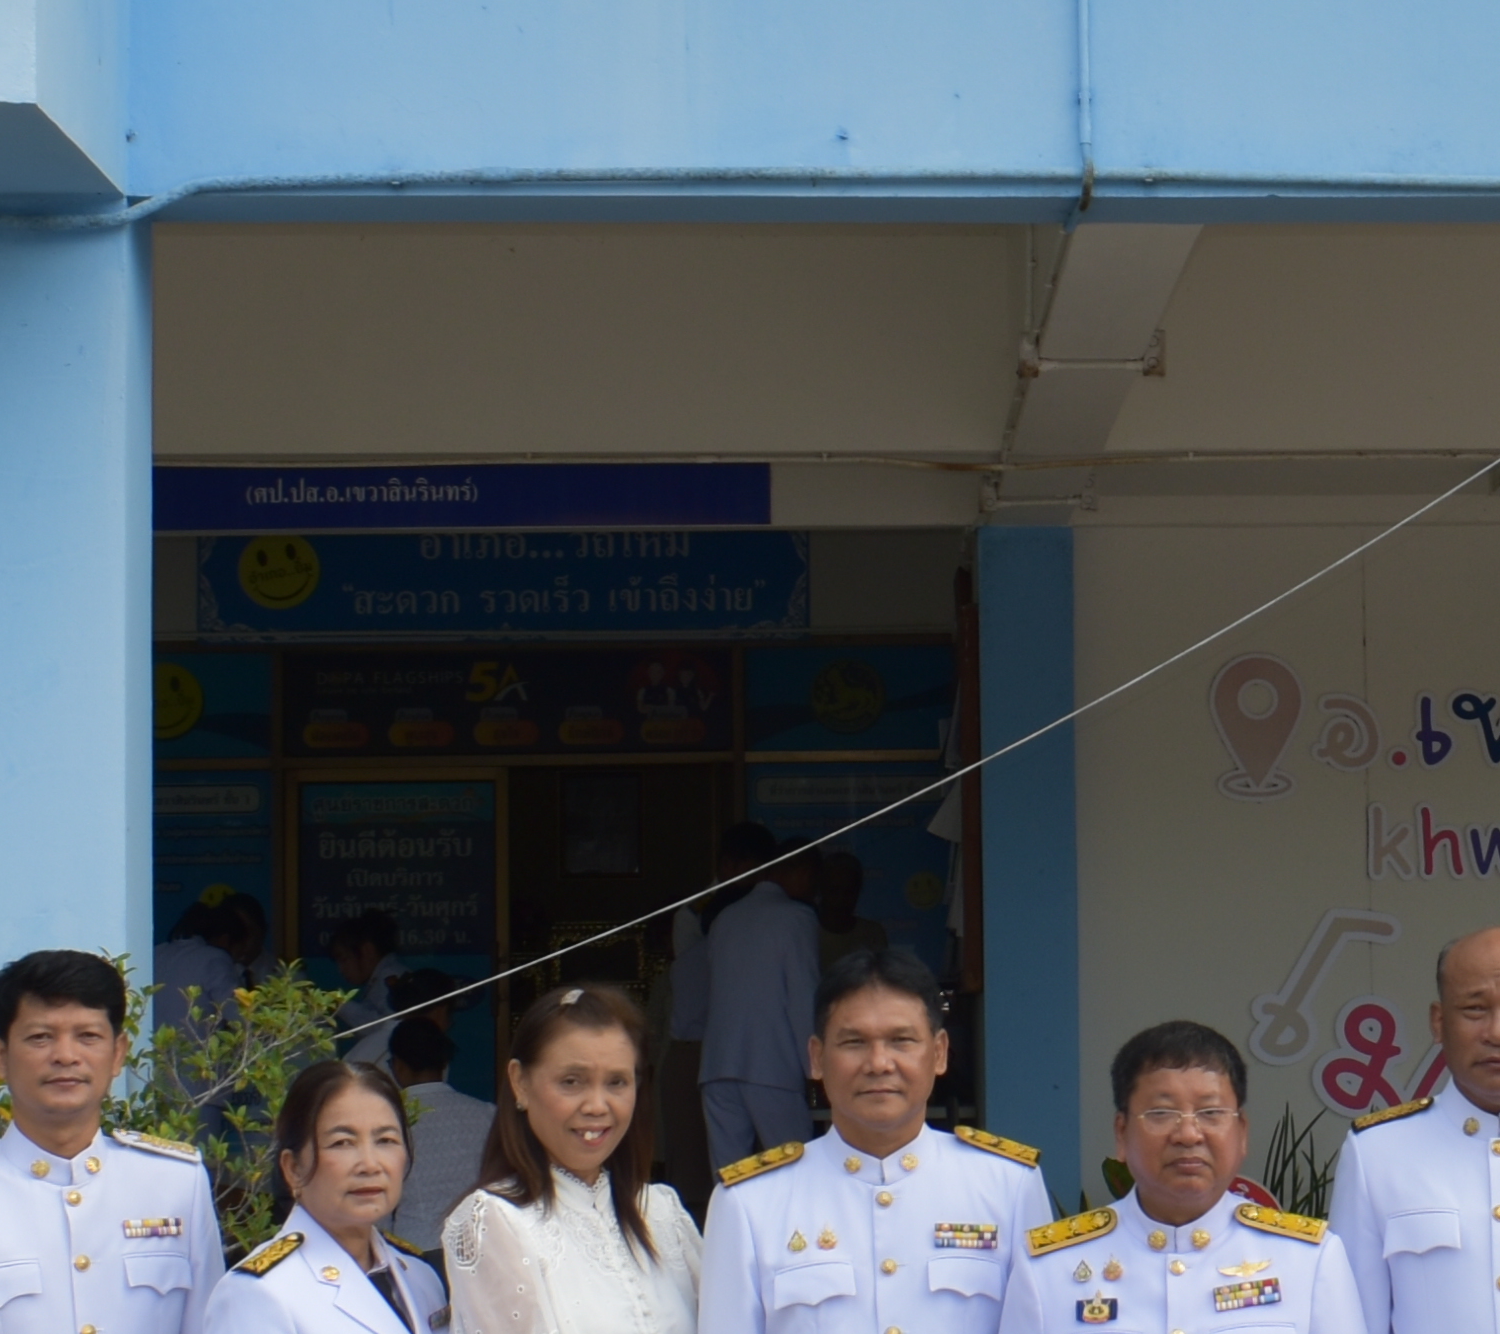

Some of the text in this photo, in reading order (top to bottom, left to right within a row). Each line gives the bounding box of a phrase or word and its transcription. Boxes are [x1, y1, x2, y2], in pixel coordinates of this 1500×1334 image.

[318, 828, 473, 860] ยินดีต้อนรับ
[345, 867, 445, 887] เปิดบริการ
